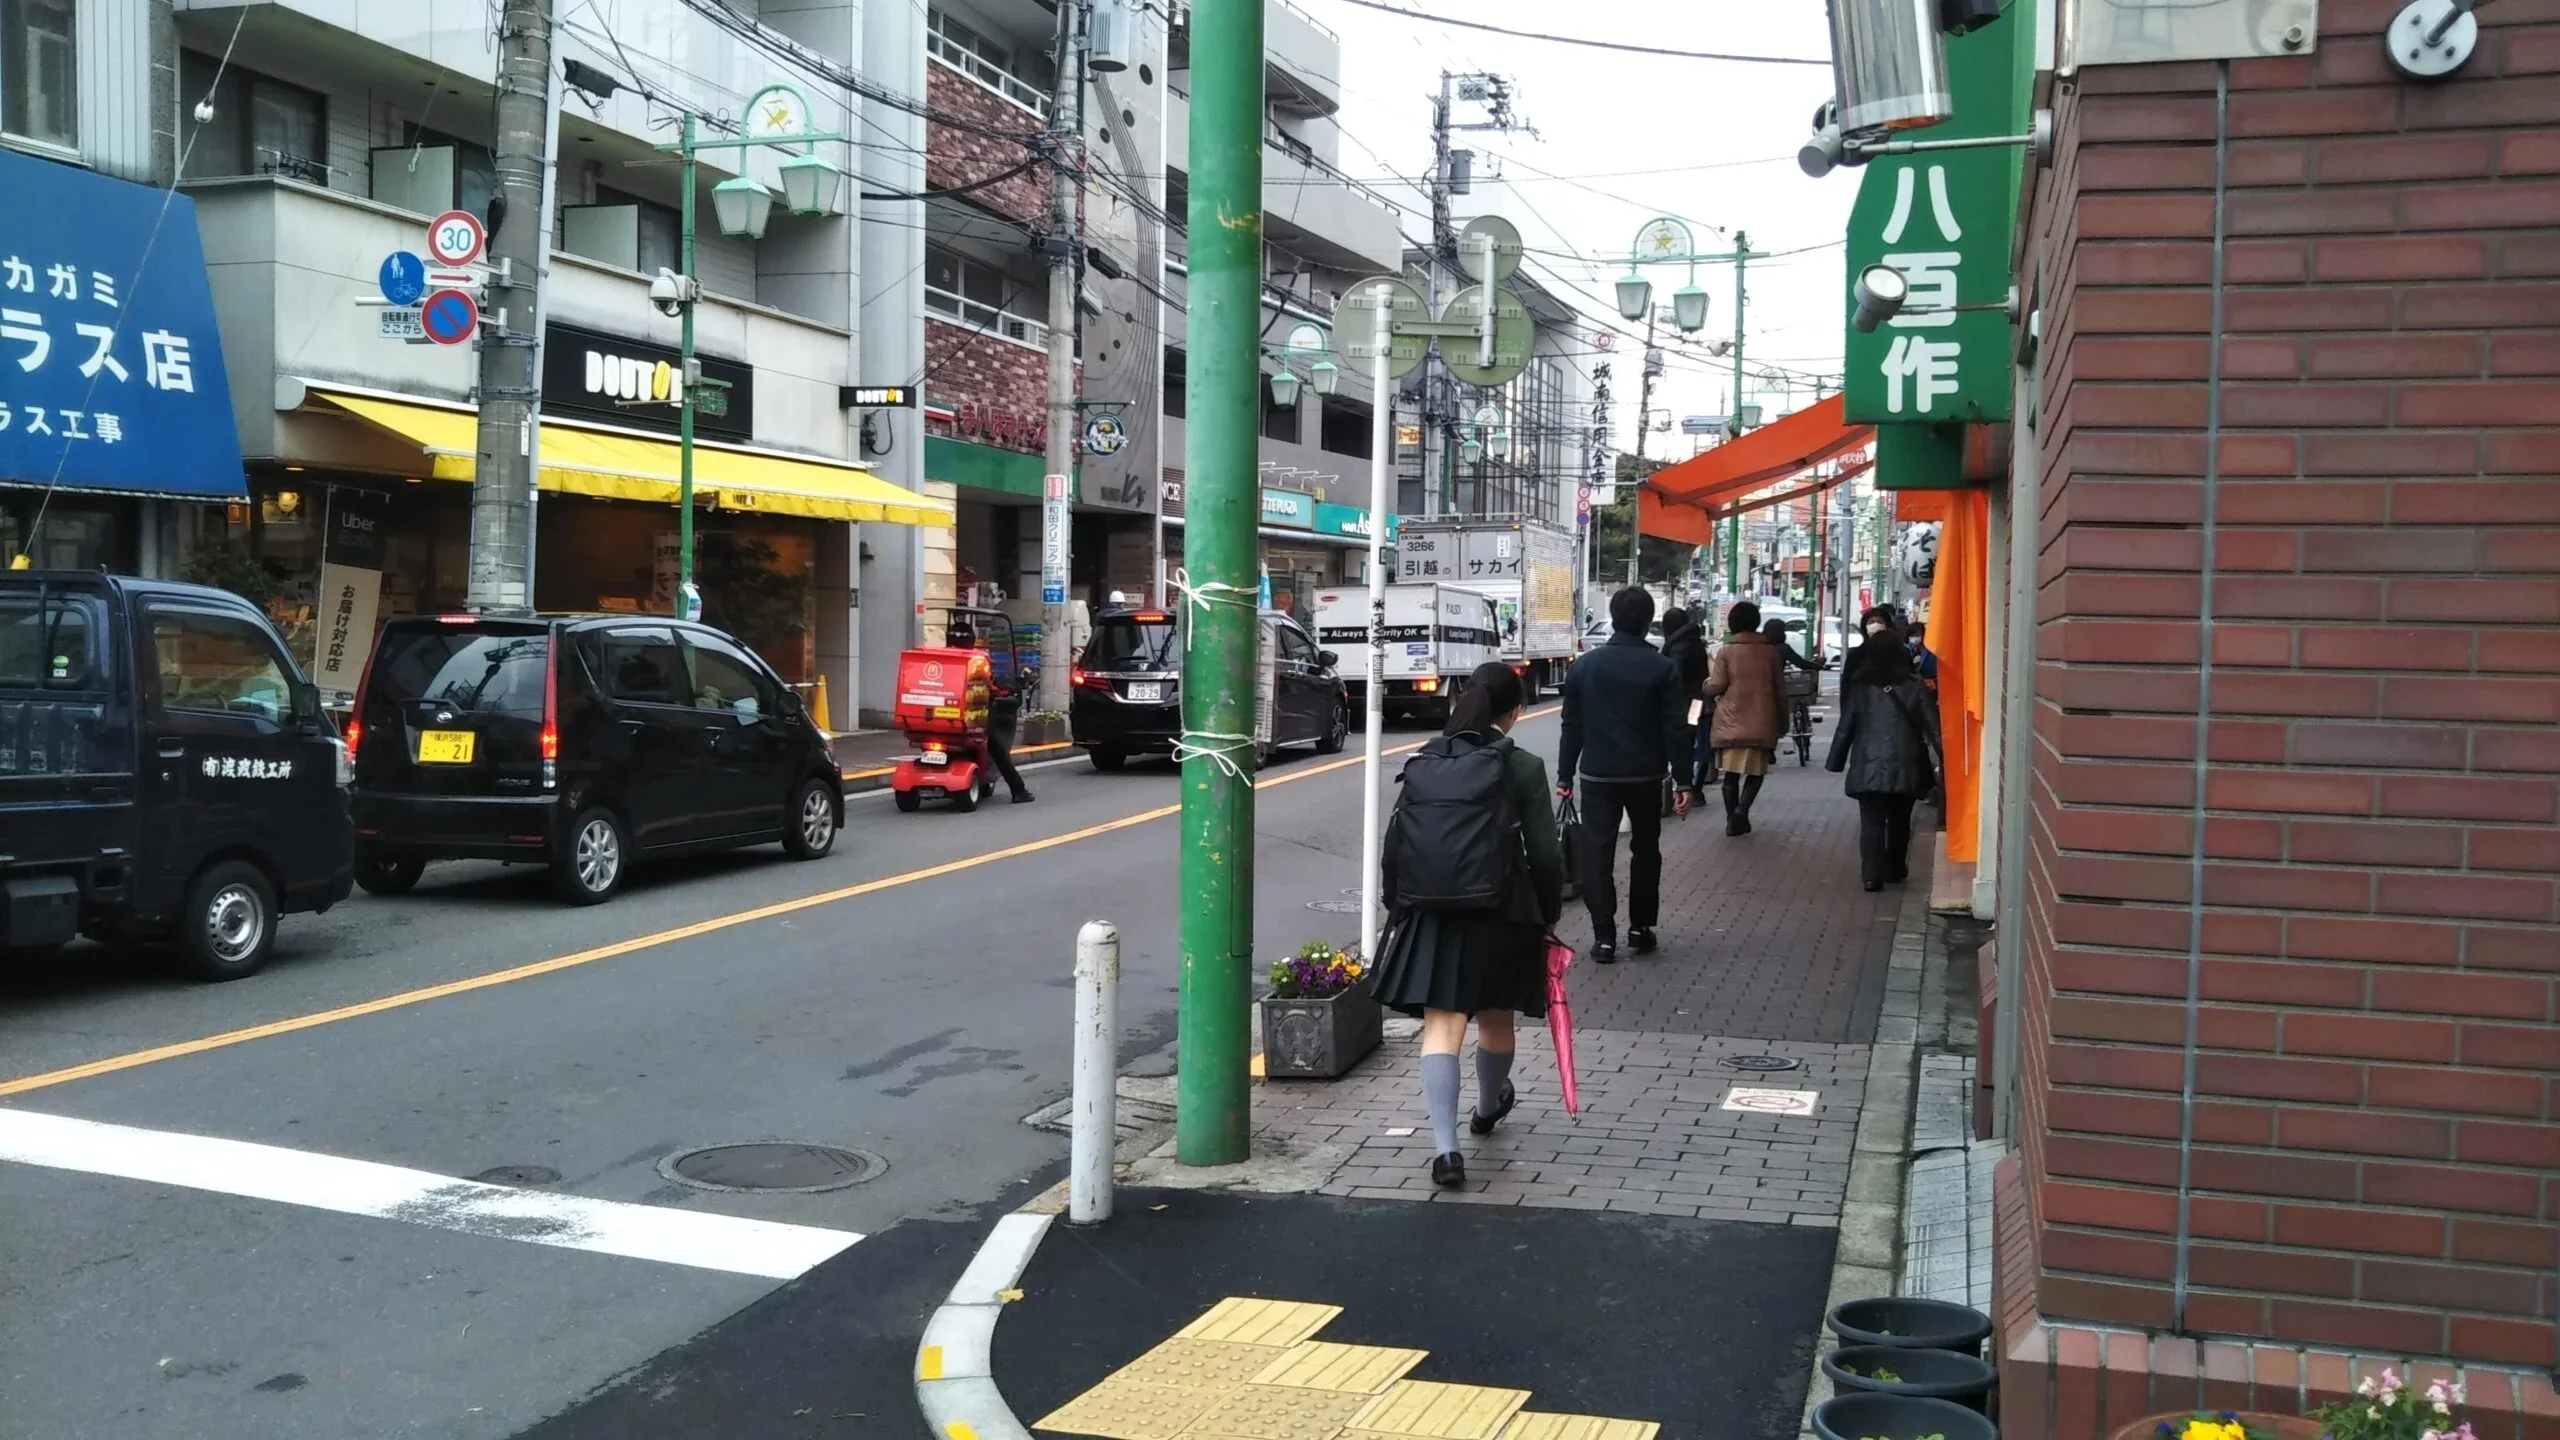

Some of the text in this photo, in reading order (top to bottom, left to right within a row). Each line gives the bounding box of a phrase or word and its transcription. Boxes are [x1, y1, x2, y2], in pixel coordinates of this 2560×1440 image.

[441, 227, 471, 251] 30
[2, 254, 119, 309] カガミ
[1881, 165, 1962, 413] 八百作
[382, 323, 423, 334] ここから
[0, 307, 195, 393] ラス店
[856, 389, 905, 404] DOUTOR
[1591, 360, 1617, 495] 城南信用金庫
[341, 512, 376, 532] Uber
[1047, 504, 1061, 563] 和田クリニック
[1407, 541, 1435, 552] 3266
[1405, 558, 1522, 576] 引越の サカイ
[325, 583, 356, 673] お届け対応店
[1404, 628, 1418, 636] OK
